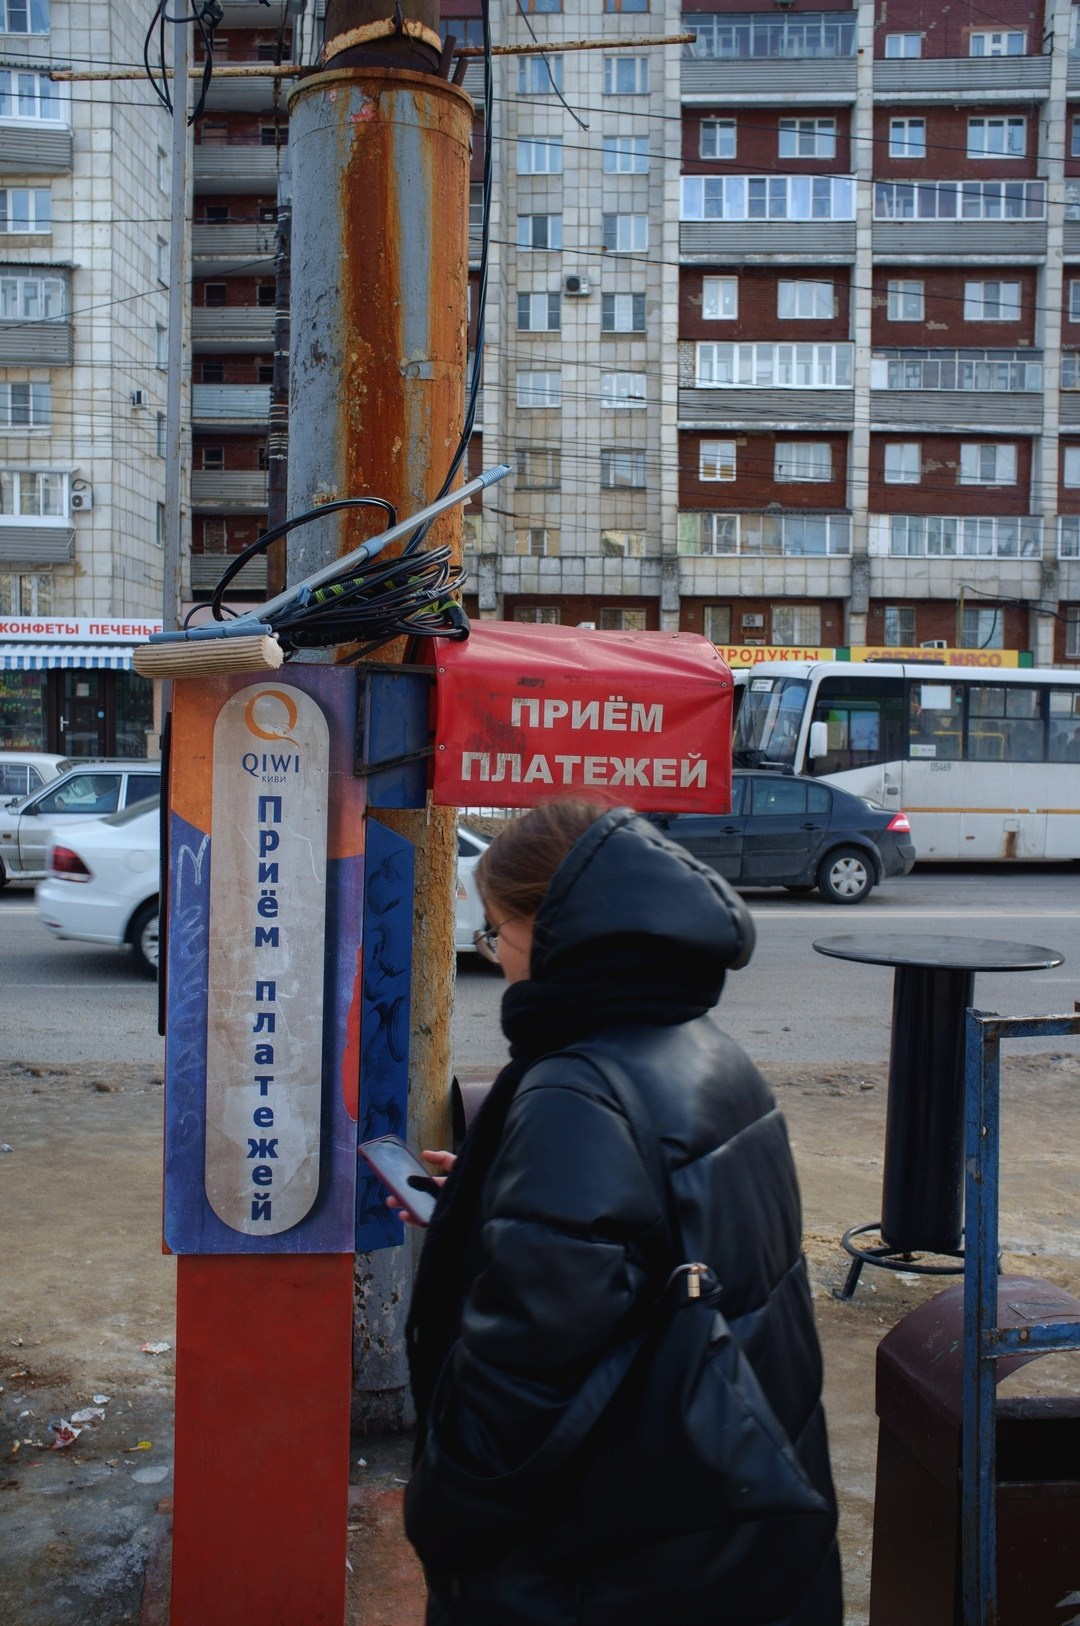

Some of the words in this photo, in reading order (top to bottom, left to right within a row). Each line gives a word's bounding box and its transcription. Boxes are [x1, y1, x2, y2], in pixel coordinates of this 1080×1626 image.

[0, 623, 79, 634] КОНФЕТЫ
[89, 624, 163, 636] ПЕЧЕНЬЕ
[950, 652, 1002, 668] МЯСО
[510, 695, 664, 733] ПРИЁМ
[242, 752, 300, 777] QIWI
[261, 775, 287, 783] КИВИ
[460, 752, 708, 788] ПЛАТЕЖЕЙ
[254, 795, 282, 948] Приём
[246, 980, 279, 1221] платежей
